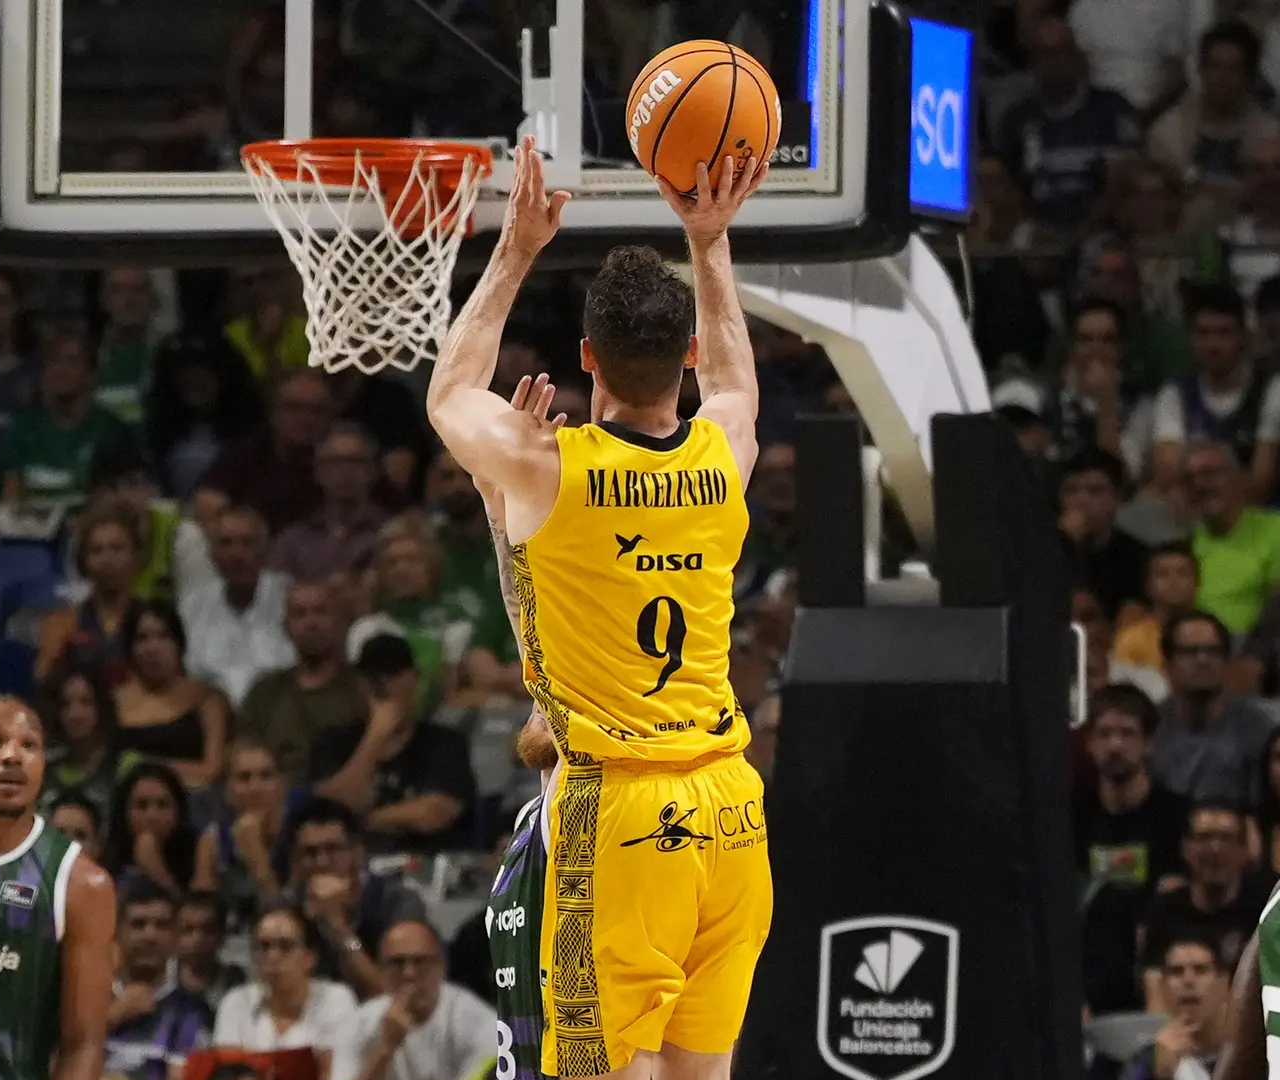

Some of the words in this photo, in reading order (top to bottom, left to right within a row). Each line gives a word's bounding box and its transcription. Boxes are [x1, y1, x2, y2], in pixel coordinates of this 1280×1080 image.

[911, 85, 963, 169] sa
[585, 468, 727, 508] MARCELINHO
[637, 595, 687, 697] 9
[654, 719, 696, 732] IBERIA
[718, 797, 765, 837] CIC
[852, 1019, 921, 1039] Unicaja
